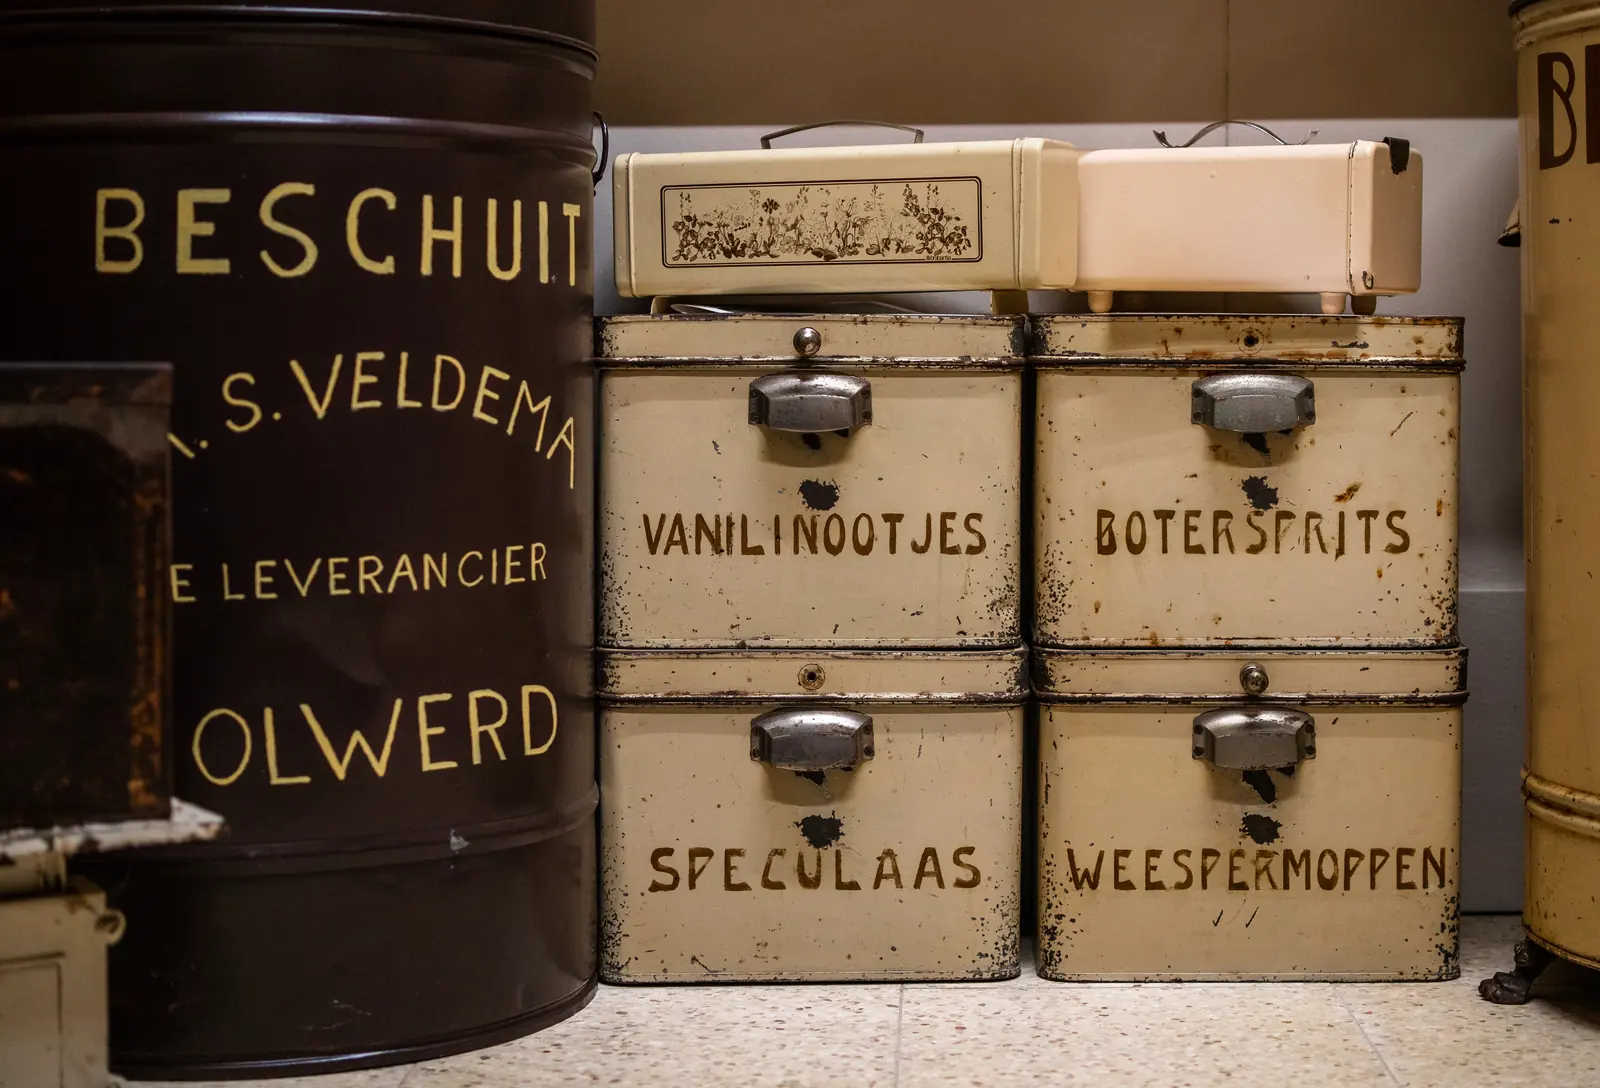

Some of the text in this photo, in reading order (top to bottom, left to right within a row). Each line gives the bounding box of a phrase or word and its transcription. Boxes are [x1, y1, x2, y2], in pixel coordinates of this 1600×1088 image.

[95, 182, 581, 287] BESCHUIT
[222, 351, 576, 490] S. VELDEMA
[642, 512, 988, 556] VANILINOOTJES
[1096, 509, 1411, 559] BOTERSPRITS
[222, 543, 548, 600] LEVERANCIER
[648, 846, 982, 892] SPECULAAS
[1066, 847, 1447, 892] WEESPERMOPPEN
